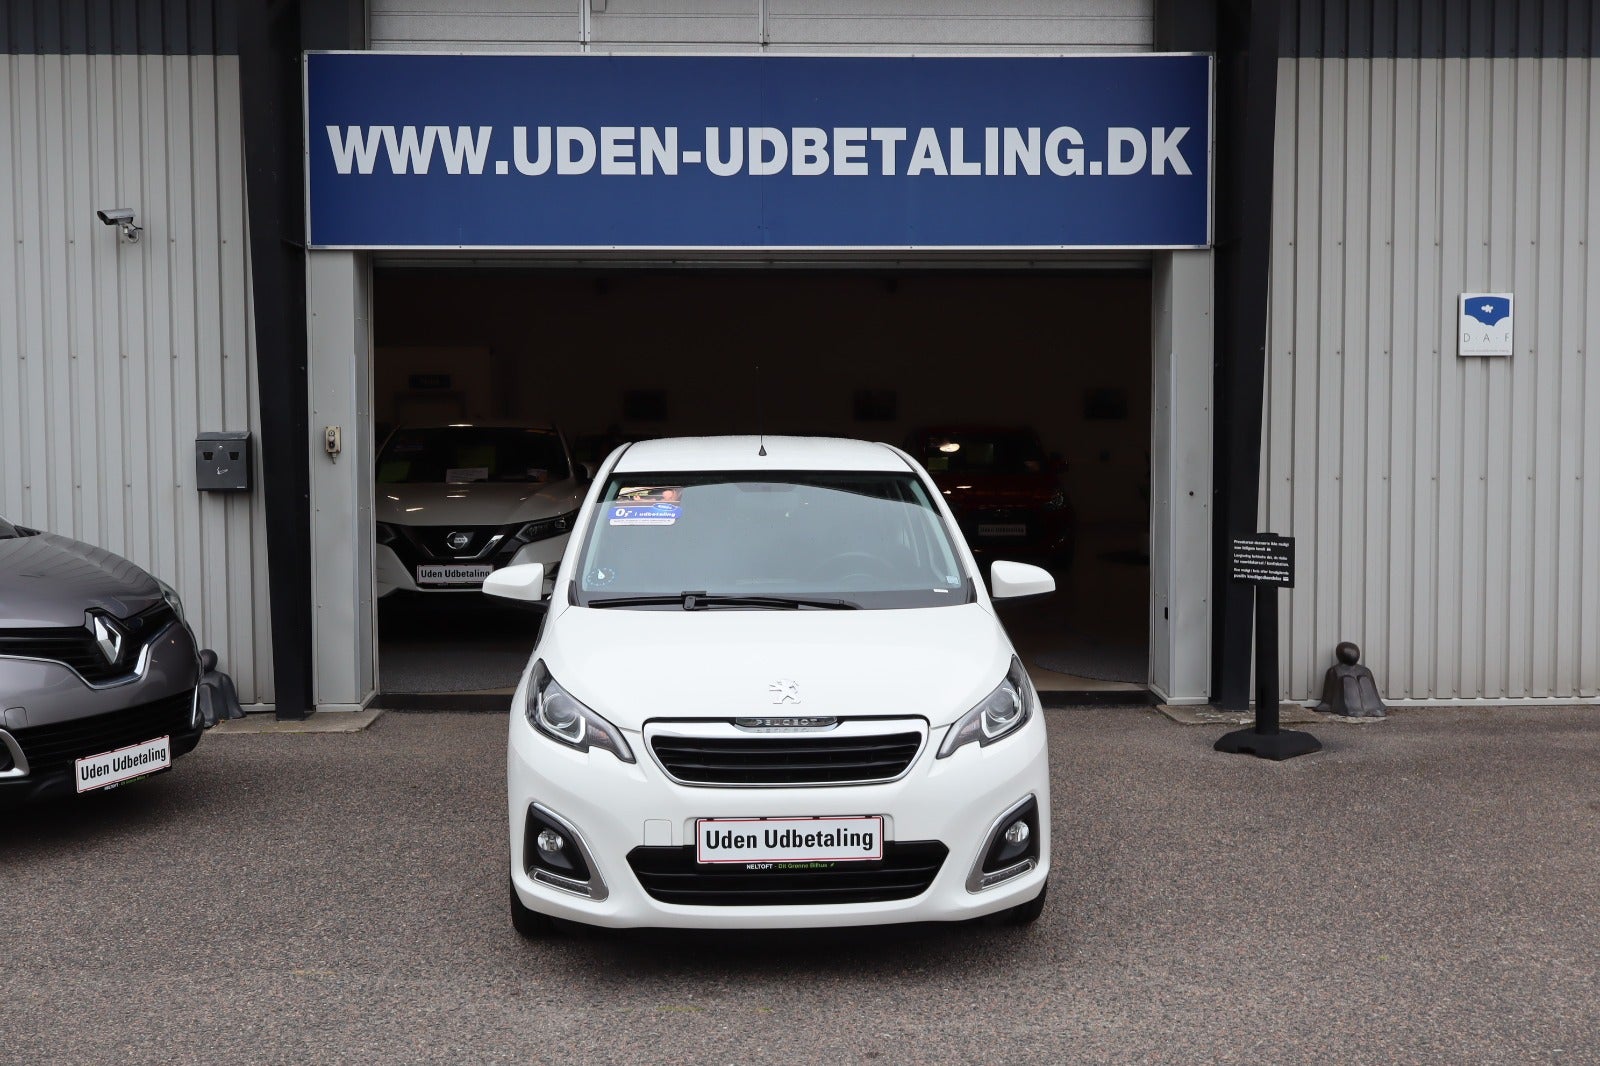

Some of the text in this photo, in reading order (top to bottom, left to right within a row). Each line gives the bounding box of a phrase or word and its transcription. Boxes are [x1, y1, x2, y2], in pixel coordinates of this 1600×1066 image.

[326, 125, 1193, 176] WWW.UDEN-UDBETALING.DK
[421, 570, 442, 578] Uden
[755, 718, 818, 726] PEUGEOT
[81, 763, 110, 781] Uden
[112, 747, 167, 773] Udbetaling
[706, 828, 874, 851] Uden Udbetaling
